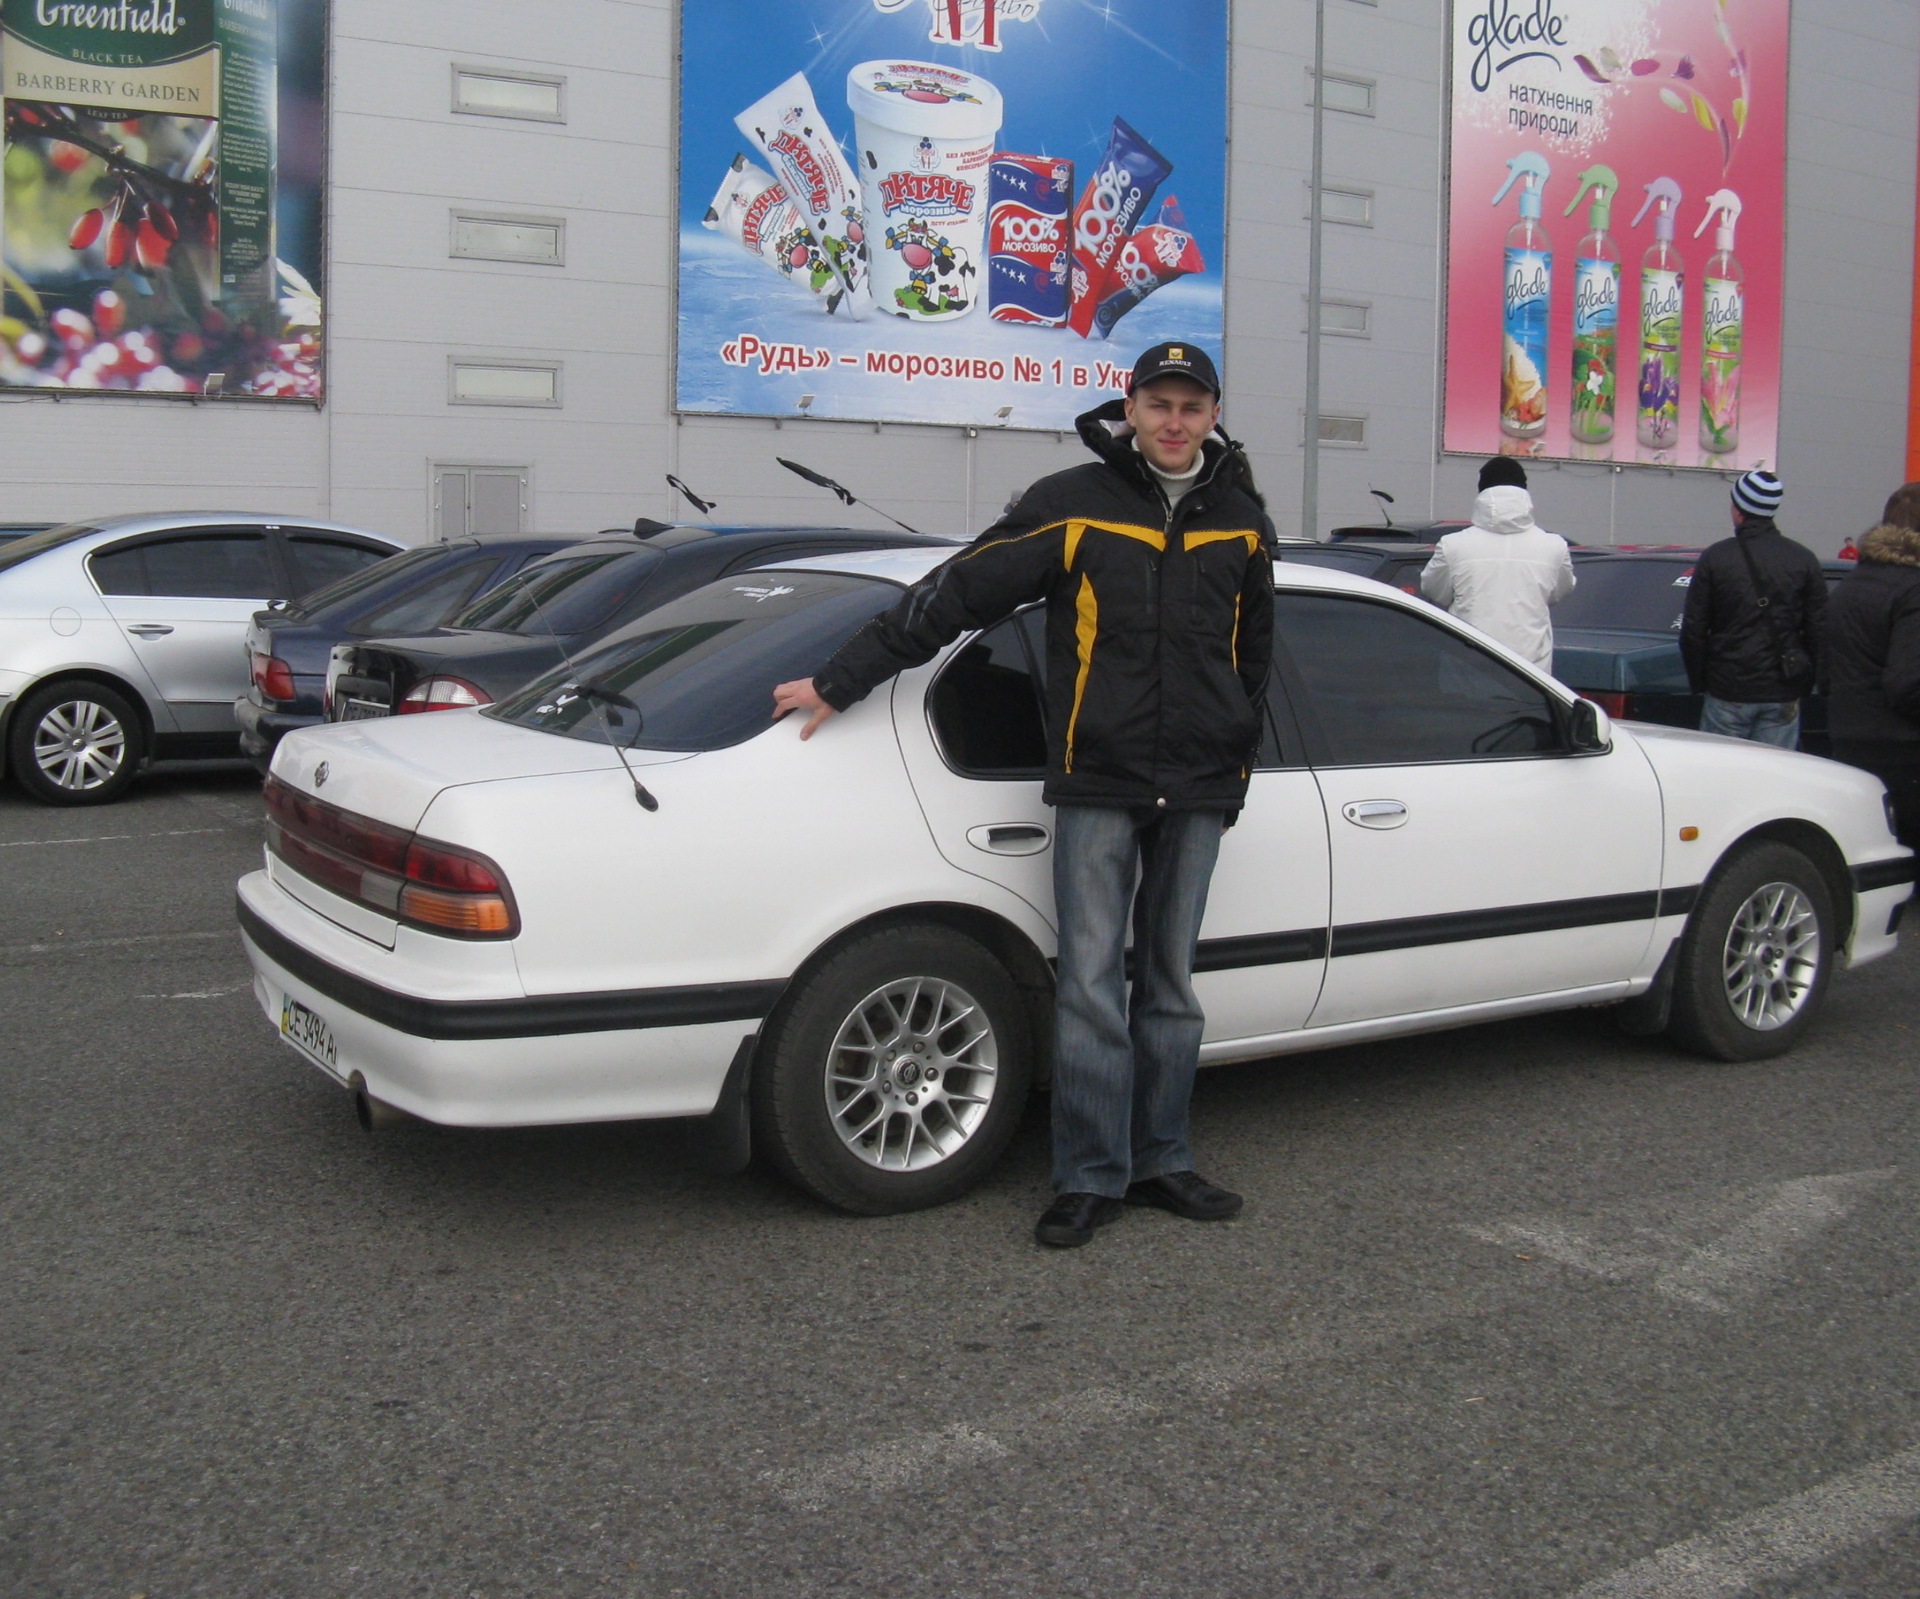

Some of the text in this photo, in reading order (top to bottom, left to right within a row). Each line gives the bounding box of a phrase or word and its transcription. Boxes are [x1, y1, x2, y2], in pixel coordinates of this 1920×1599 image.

[72, 49, 143, 64] BLACK TEA
[1468, 0, 1568, 92] glade
[17, 72, 200, 101] BARBERRY GARDEN
[1509, 84, 1593, 115] натхнення
[1509, 108, 1578, 138] природи
[879, 172, 975, 215] ДИТЯЧЕ
[900, 205, 957, 217] морозиво
[1074, 161, 1131, 256] 100%
[999, 215, 1060, 244] 100%
[1002, 241, 1057, 254] МОРОЗИВО
[1096, 187, 1141, 269] МОРОЗИВО
[1506, 267, 1546, 320] glade
[1577, 277, 1615, 329] glade
[1643, 286, 1679, 337] glade
[1705, 295, 1740, 345] glade
[722, 336, 831, 372] «Рудь»
[867, 352, 1004, 381] морозиво
[1014, 356, 1042, 383] №
[1052, 359, 1062, 384] 1
[1073, 367, 1088, 386] в
